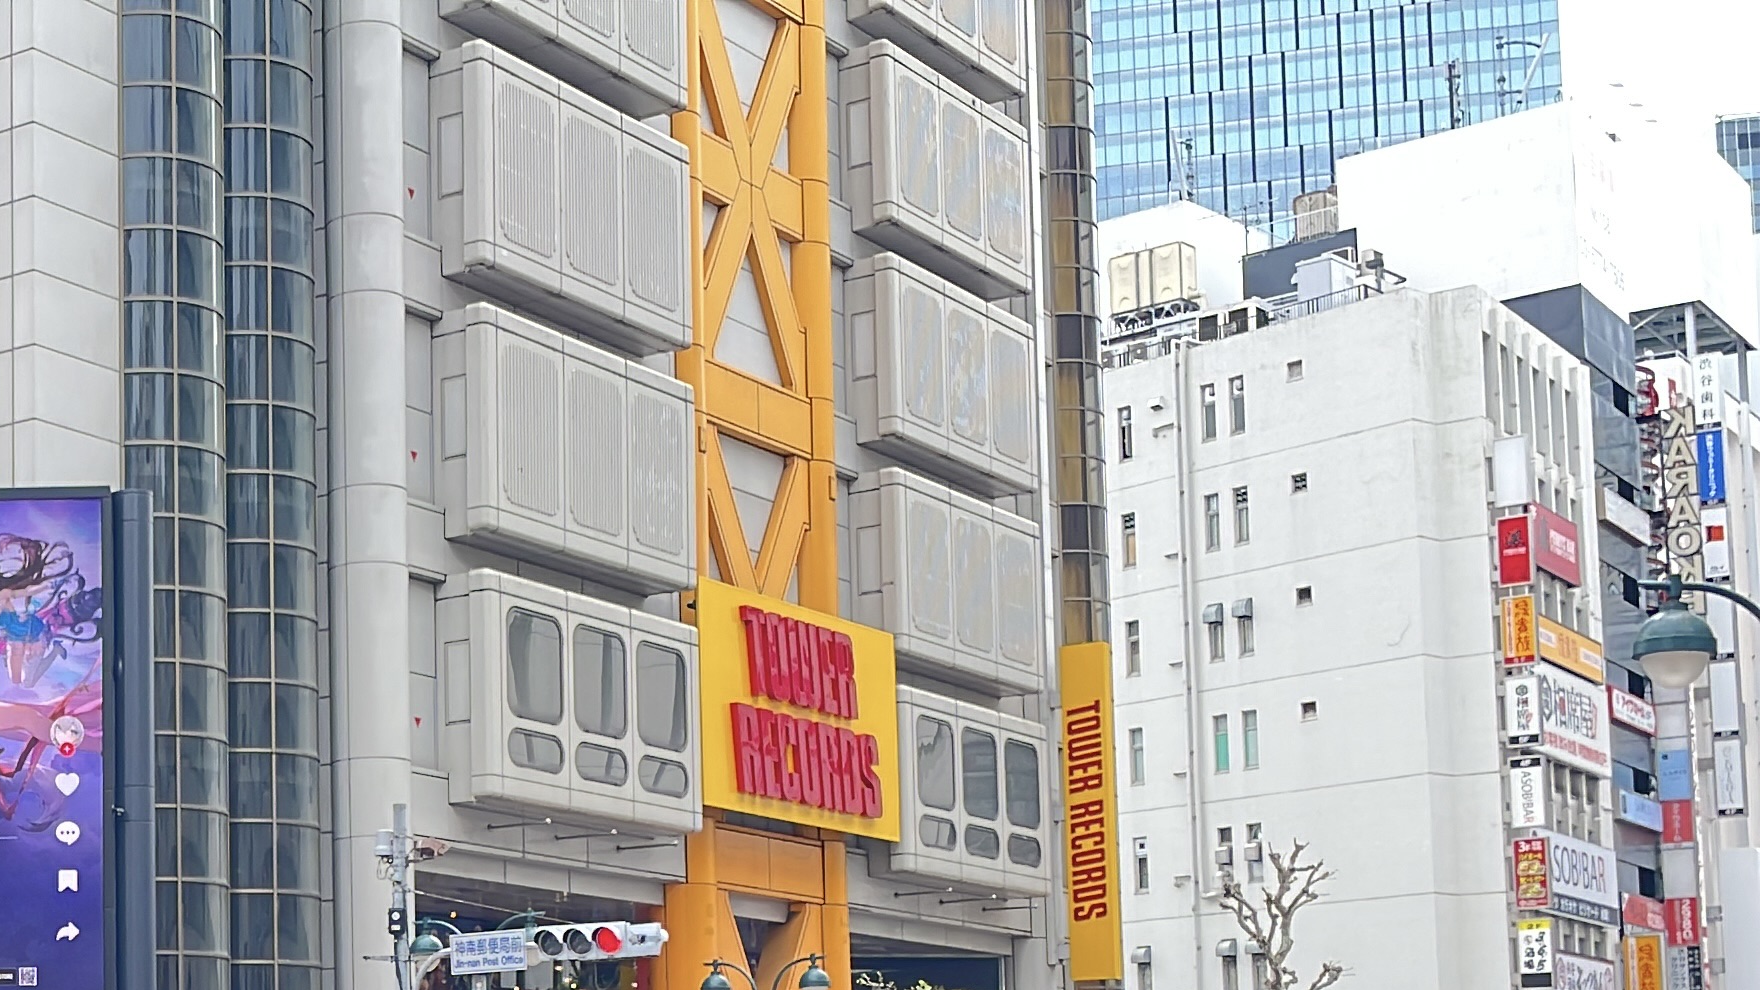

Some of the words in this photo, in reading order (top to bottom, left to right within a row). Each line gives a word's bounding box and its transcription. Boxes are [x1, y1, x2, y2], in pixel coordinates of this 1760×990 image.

[1699, 357, 1715, 421] 渋谷歯科
[740, 604, 858, 720] TOWER
[730, 702, 883, 819] RECORDS
[1066, 700, 1104, 796] TOWER
[1069, 800, 1108, 923] RECORDS
[454, 936, 522, 956] 神南郵便局前
[454, 957, 481, 969] Jin-nan
[482, 956, 499, 967] Post
[501, 955, 524, 966] Office
